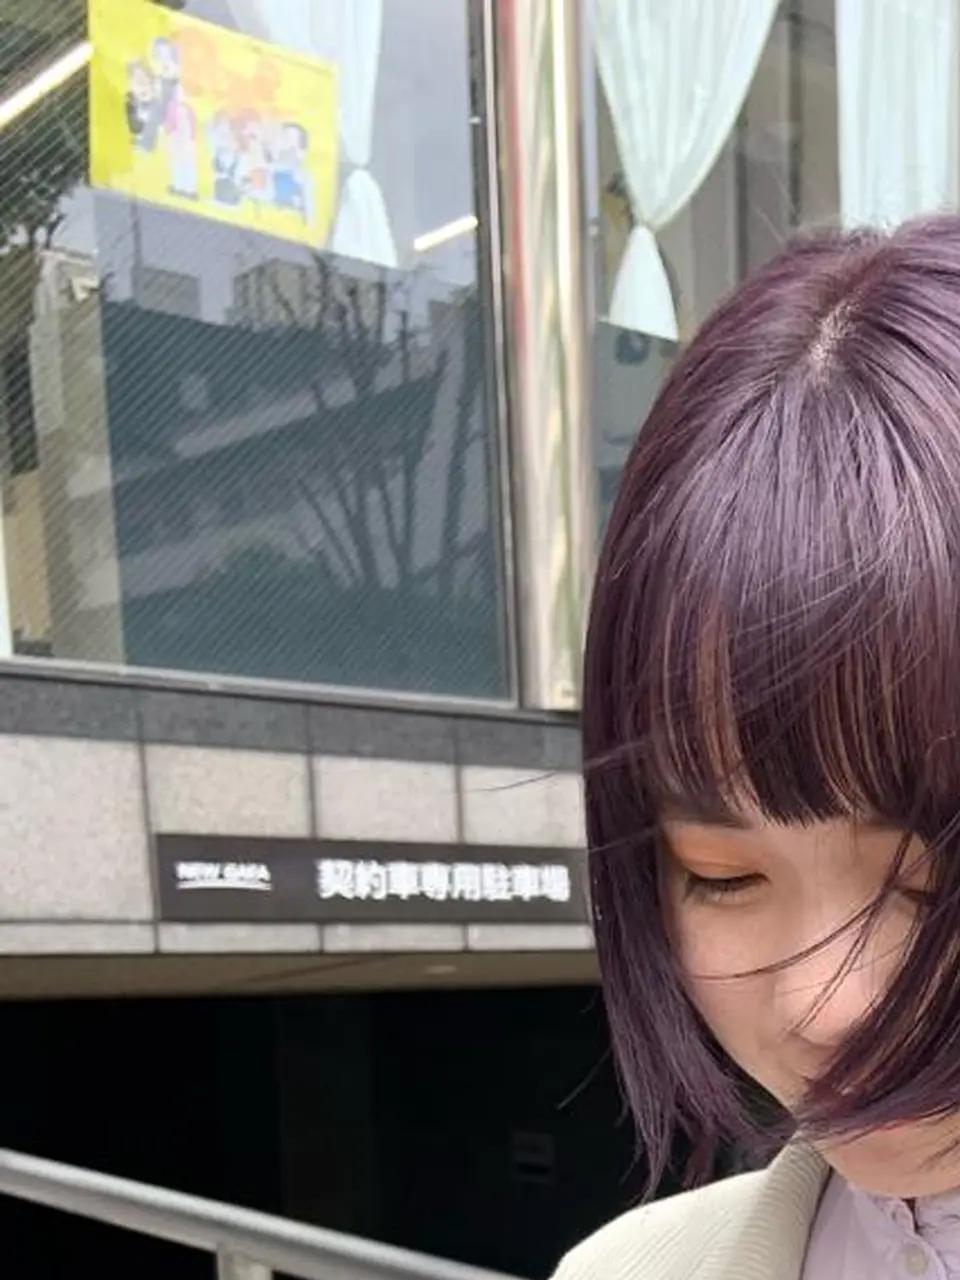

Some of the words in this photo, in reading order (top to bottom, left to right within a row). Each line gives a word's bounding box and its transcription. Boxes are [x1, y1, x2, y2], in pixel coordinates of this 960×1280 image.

[317, 858, 571, 902] 契約車専用駐車場
